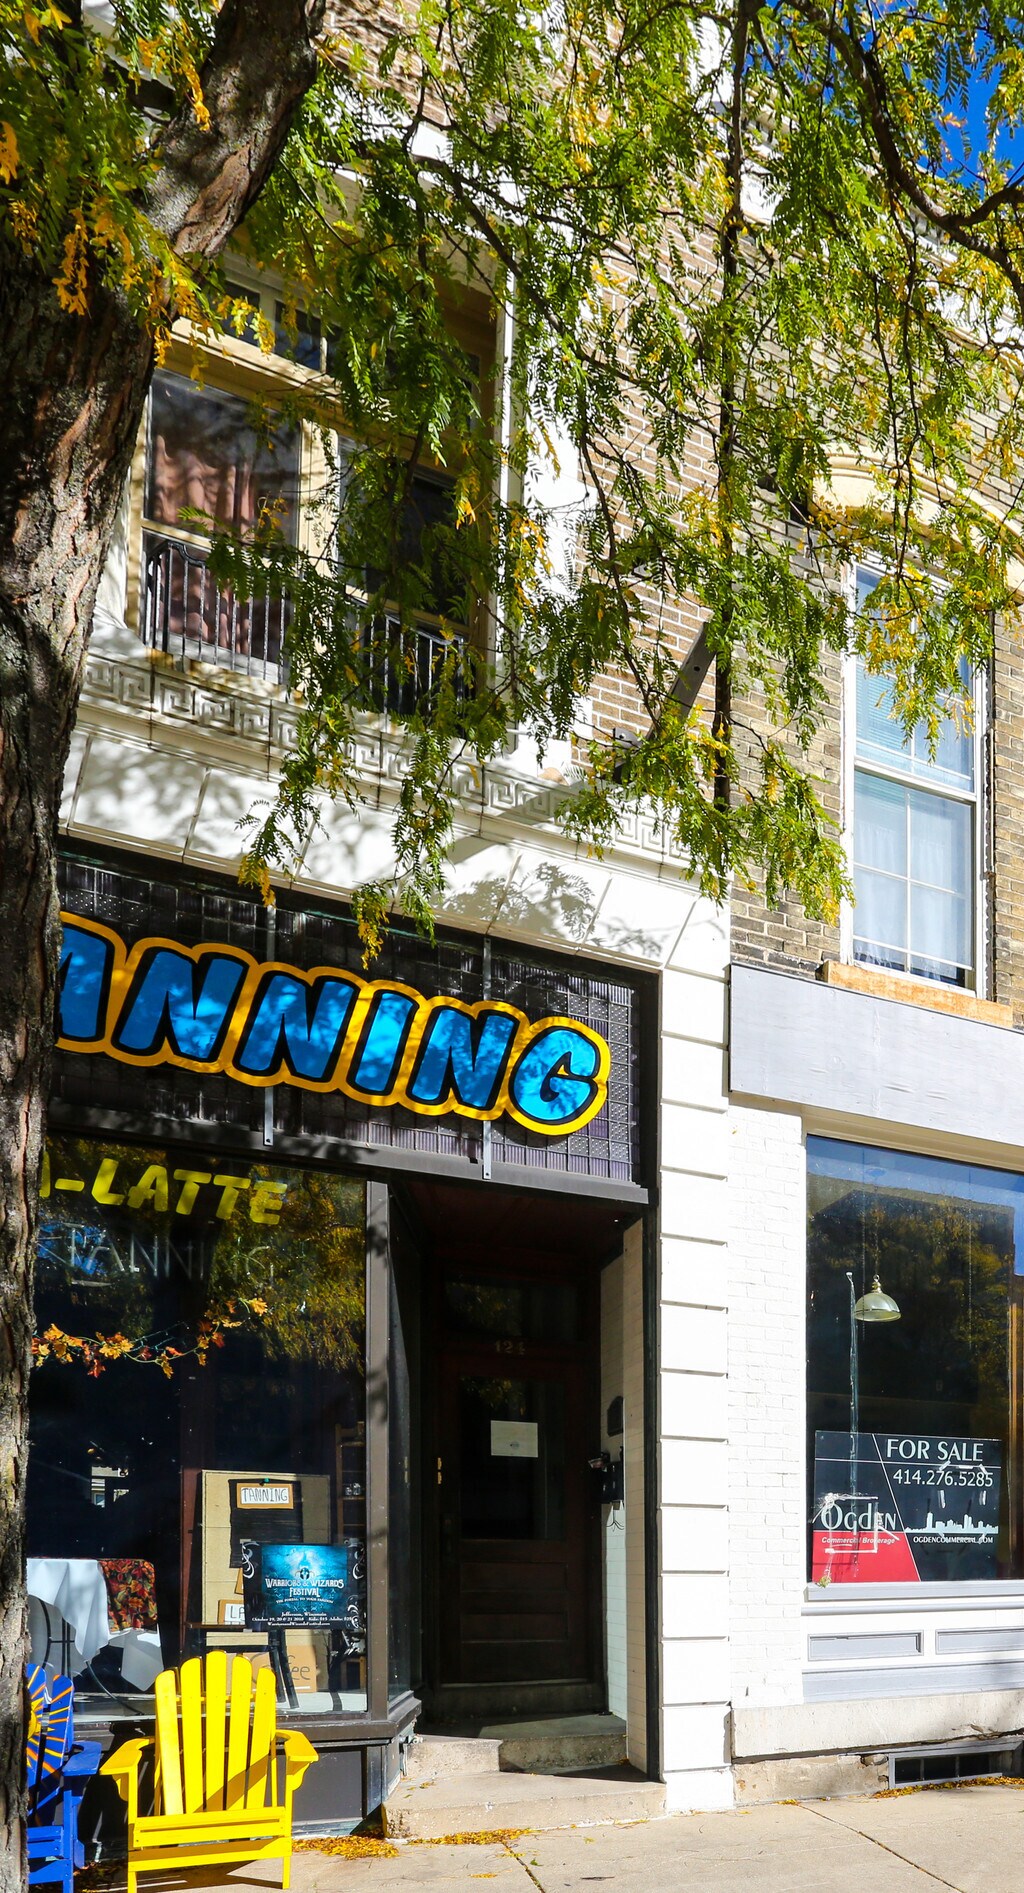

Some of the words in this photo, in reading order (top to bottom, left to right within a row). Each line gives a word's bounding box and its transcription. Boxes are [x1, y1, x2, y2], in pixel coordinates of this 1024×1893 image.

[886, 1438, 931, 1460] FOR
[937, 1440, 984, 1462] SALE
[892, 1468, 993, 1487] 414.276.5285
[241, 1487, 289, 1503] TANNING
[289, 1587, 320, 1597] FESTIVAL
